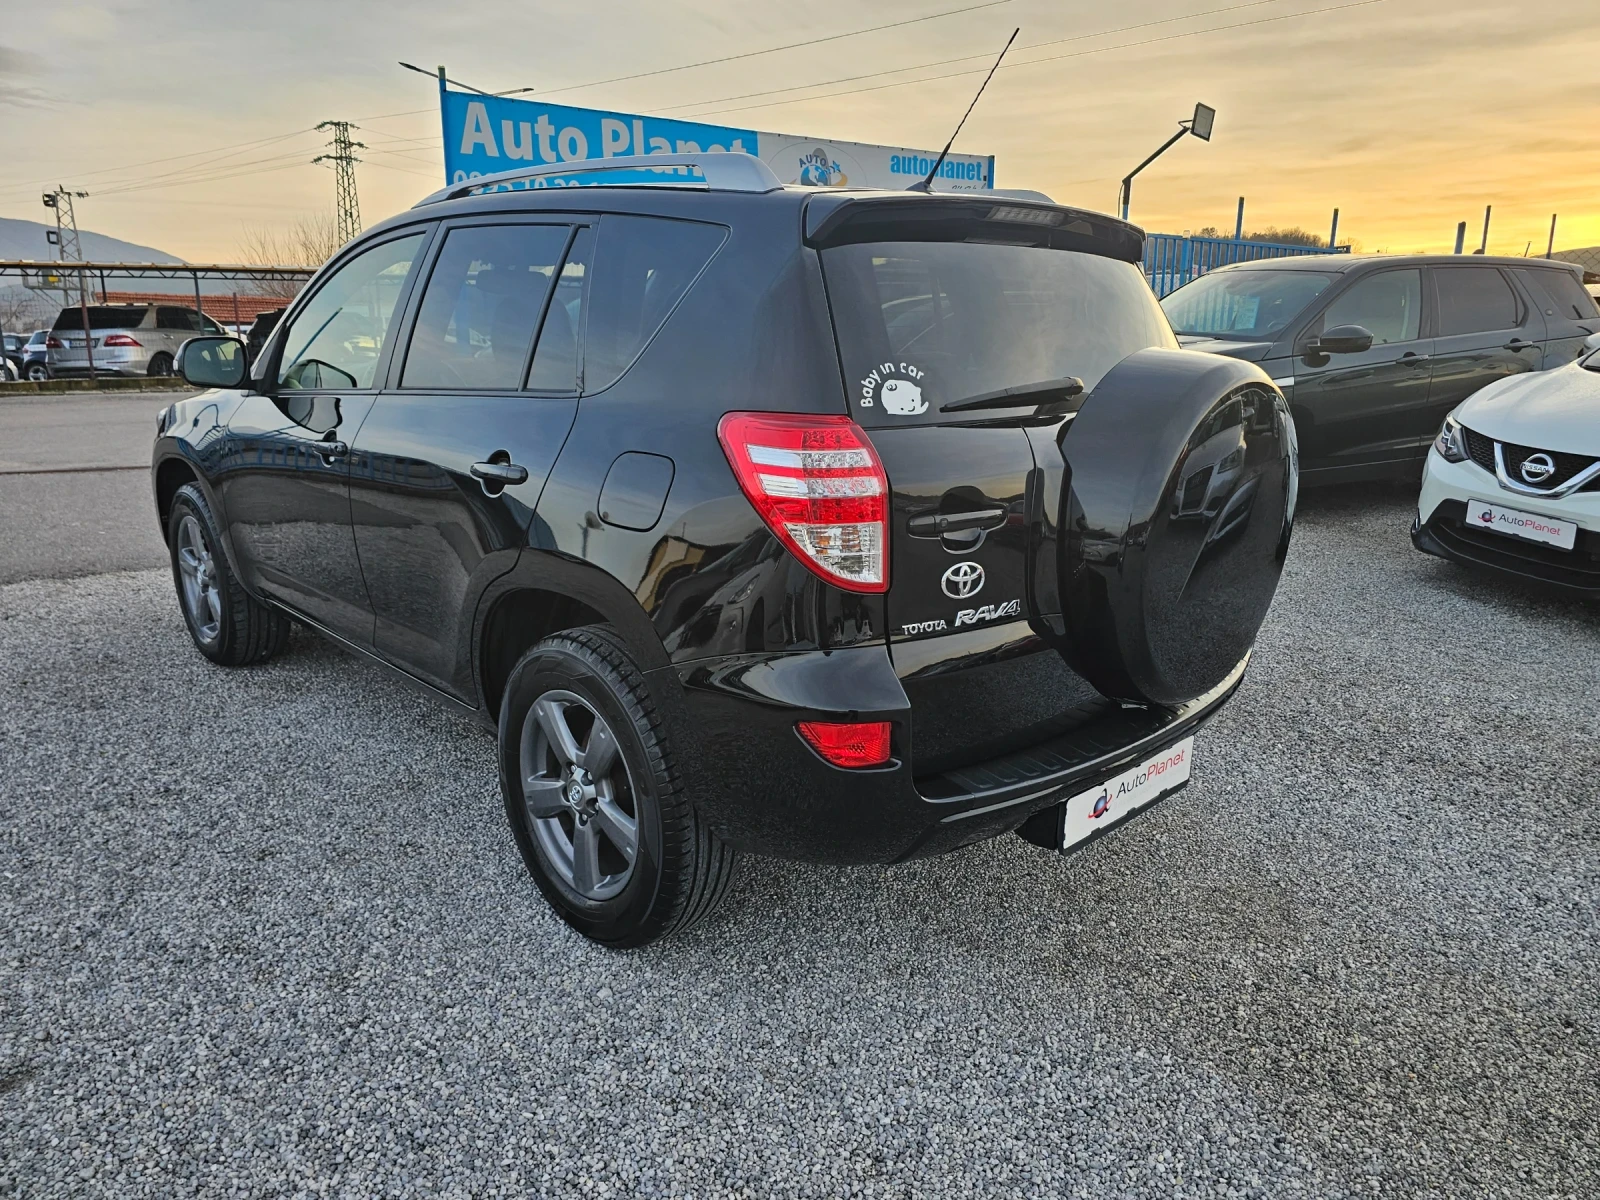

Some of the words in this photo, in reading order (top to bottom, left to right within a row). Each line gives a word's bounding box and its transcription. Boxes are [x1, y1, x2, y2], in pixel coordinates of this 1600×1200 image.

[460, 101, 589, 163] Auto
[798, 153, 827, 168] AUTO
[860, 369, 882, 408] Baby
[900, 362, 925, 380] car
[1521, 461, 1551, 474] NISSAN
[1498, 513, 1562, 537] AutoPlanet
[901, 619, 948, 636] TOYOTA
[954, 598, 1021, 628] RAV4
[1115, 748, 1186, 799] AutoPlanet
